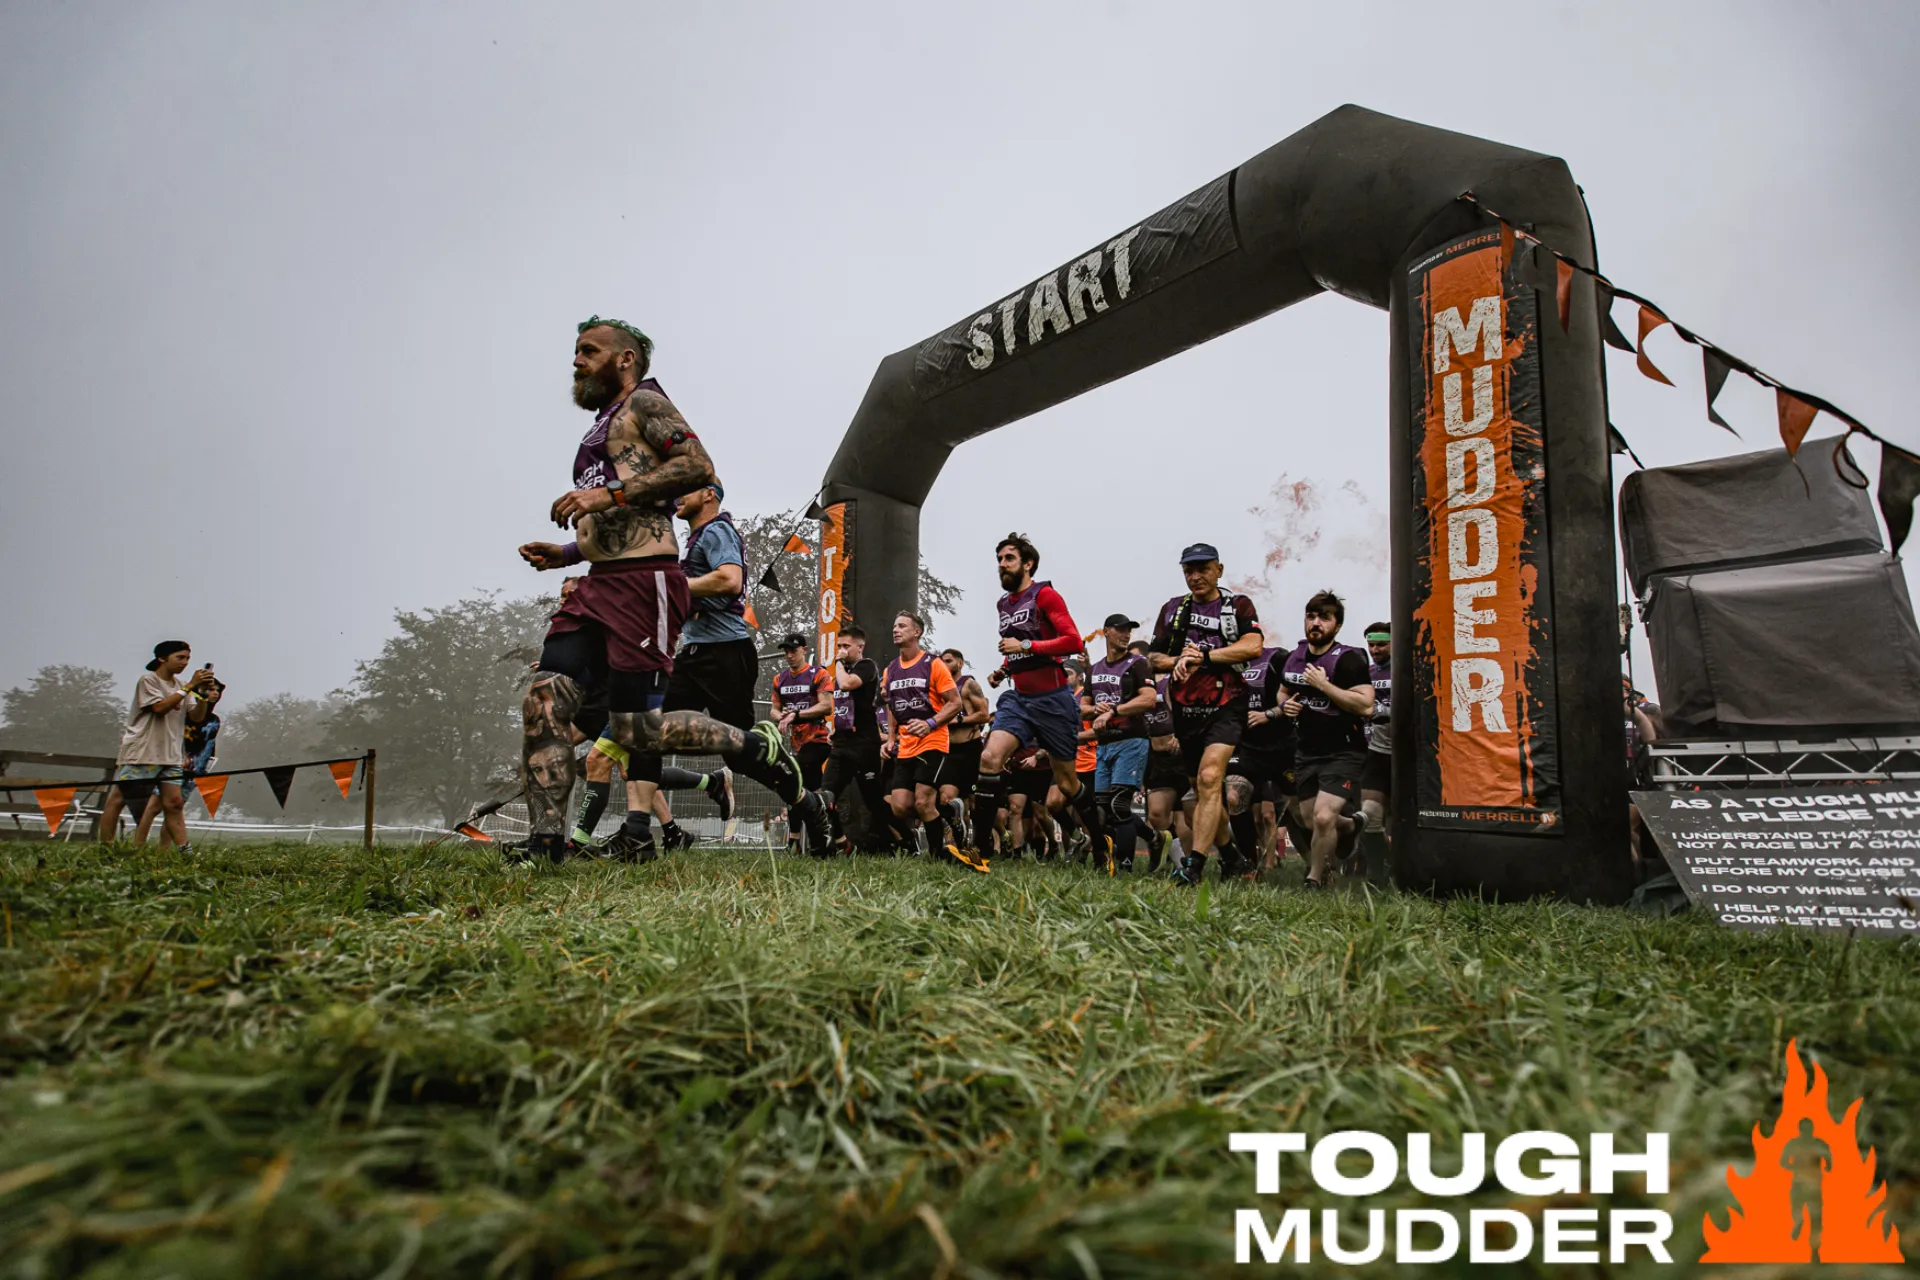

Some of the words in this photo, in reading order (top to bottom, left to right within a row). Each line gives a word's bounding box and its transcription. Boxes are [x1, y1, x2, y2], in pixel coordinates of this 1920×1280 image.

[1445, 232, 1502, 255] MERREL
[967, 225, 1142, 370] START
[1433, 295, 1512, 733] MUDDER
[821, 546, 837, 668] TOU
[1670, 798, 1713, 809] AS
[1720, 798, 1744, 808] A
[1745, 793, 1867, 808] TOUGH
[1461, 811, 1540, 824] MERRELL
[1721, 812, 1735, 822] I
[1737, 809, 1874, 822] PLEDGE
[1672, 832, 1678, 840] I
[1681, 831, 1814, 840] UNDERSTAND
[1817, 829, 1872, 840] THAT
[1677, 841, 1716, 849] NOT
[1722, 841, 1737, 849] A
[1740, 841, 1797, 850] RACE
[1800, 841, 1842, 850] BUT
[1849, 841, 1865, 849] A
[1868, 840, 1920, 849] CHA
[1685, 857, 1691, 865] I
[1694, 857, 1735, 865] PUT
[1739, 857, 1863, 866] TEAMWORK
[1868, 857, 1915, 866] AND
[1691, 866, 1773, 875] BEFORE
[1776, 867, 1808, 876] MY
[1814, 867, 1907, 877] COURSE
[1702, 884, 1708, 893] I
[1711, 884, 1742, 893] DO
[1747, 885, 1790, 895] NOT
[1795, 886, 1867, 896] WHINE
[1713, 903, 1720, 912] I
[1724, 903, 1781, 913] HELP
[1785, 905, 1818, 915] MY
[1846, 917, 1894, 929] THE
[1899, 919, 1920, 930] C
